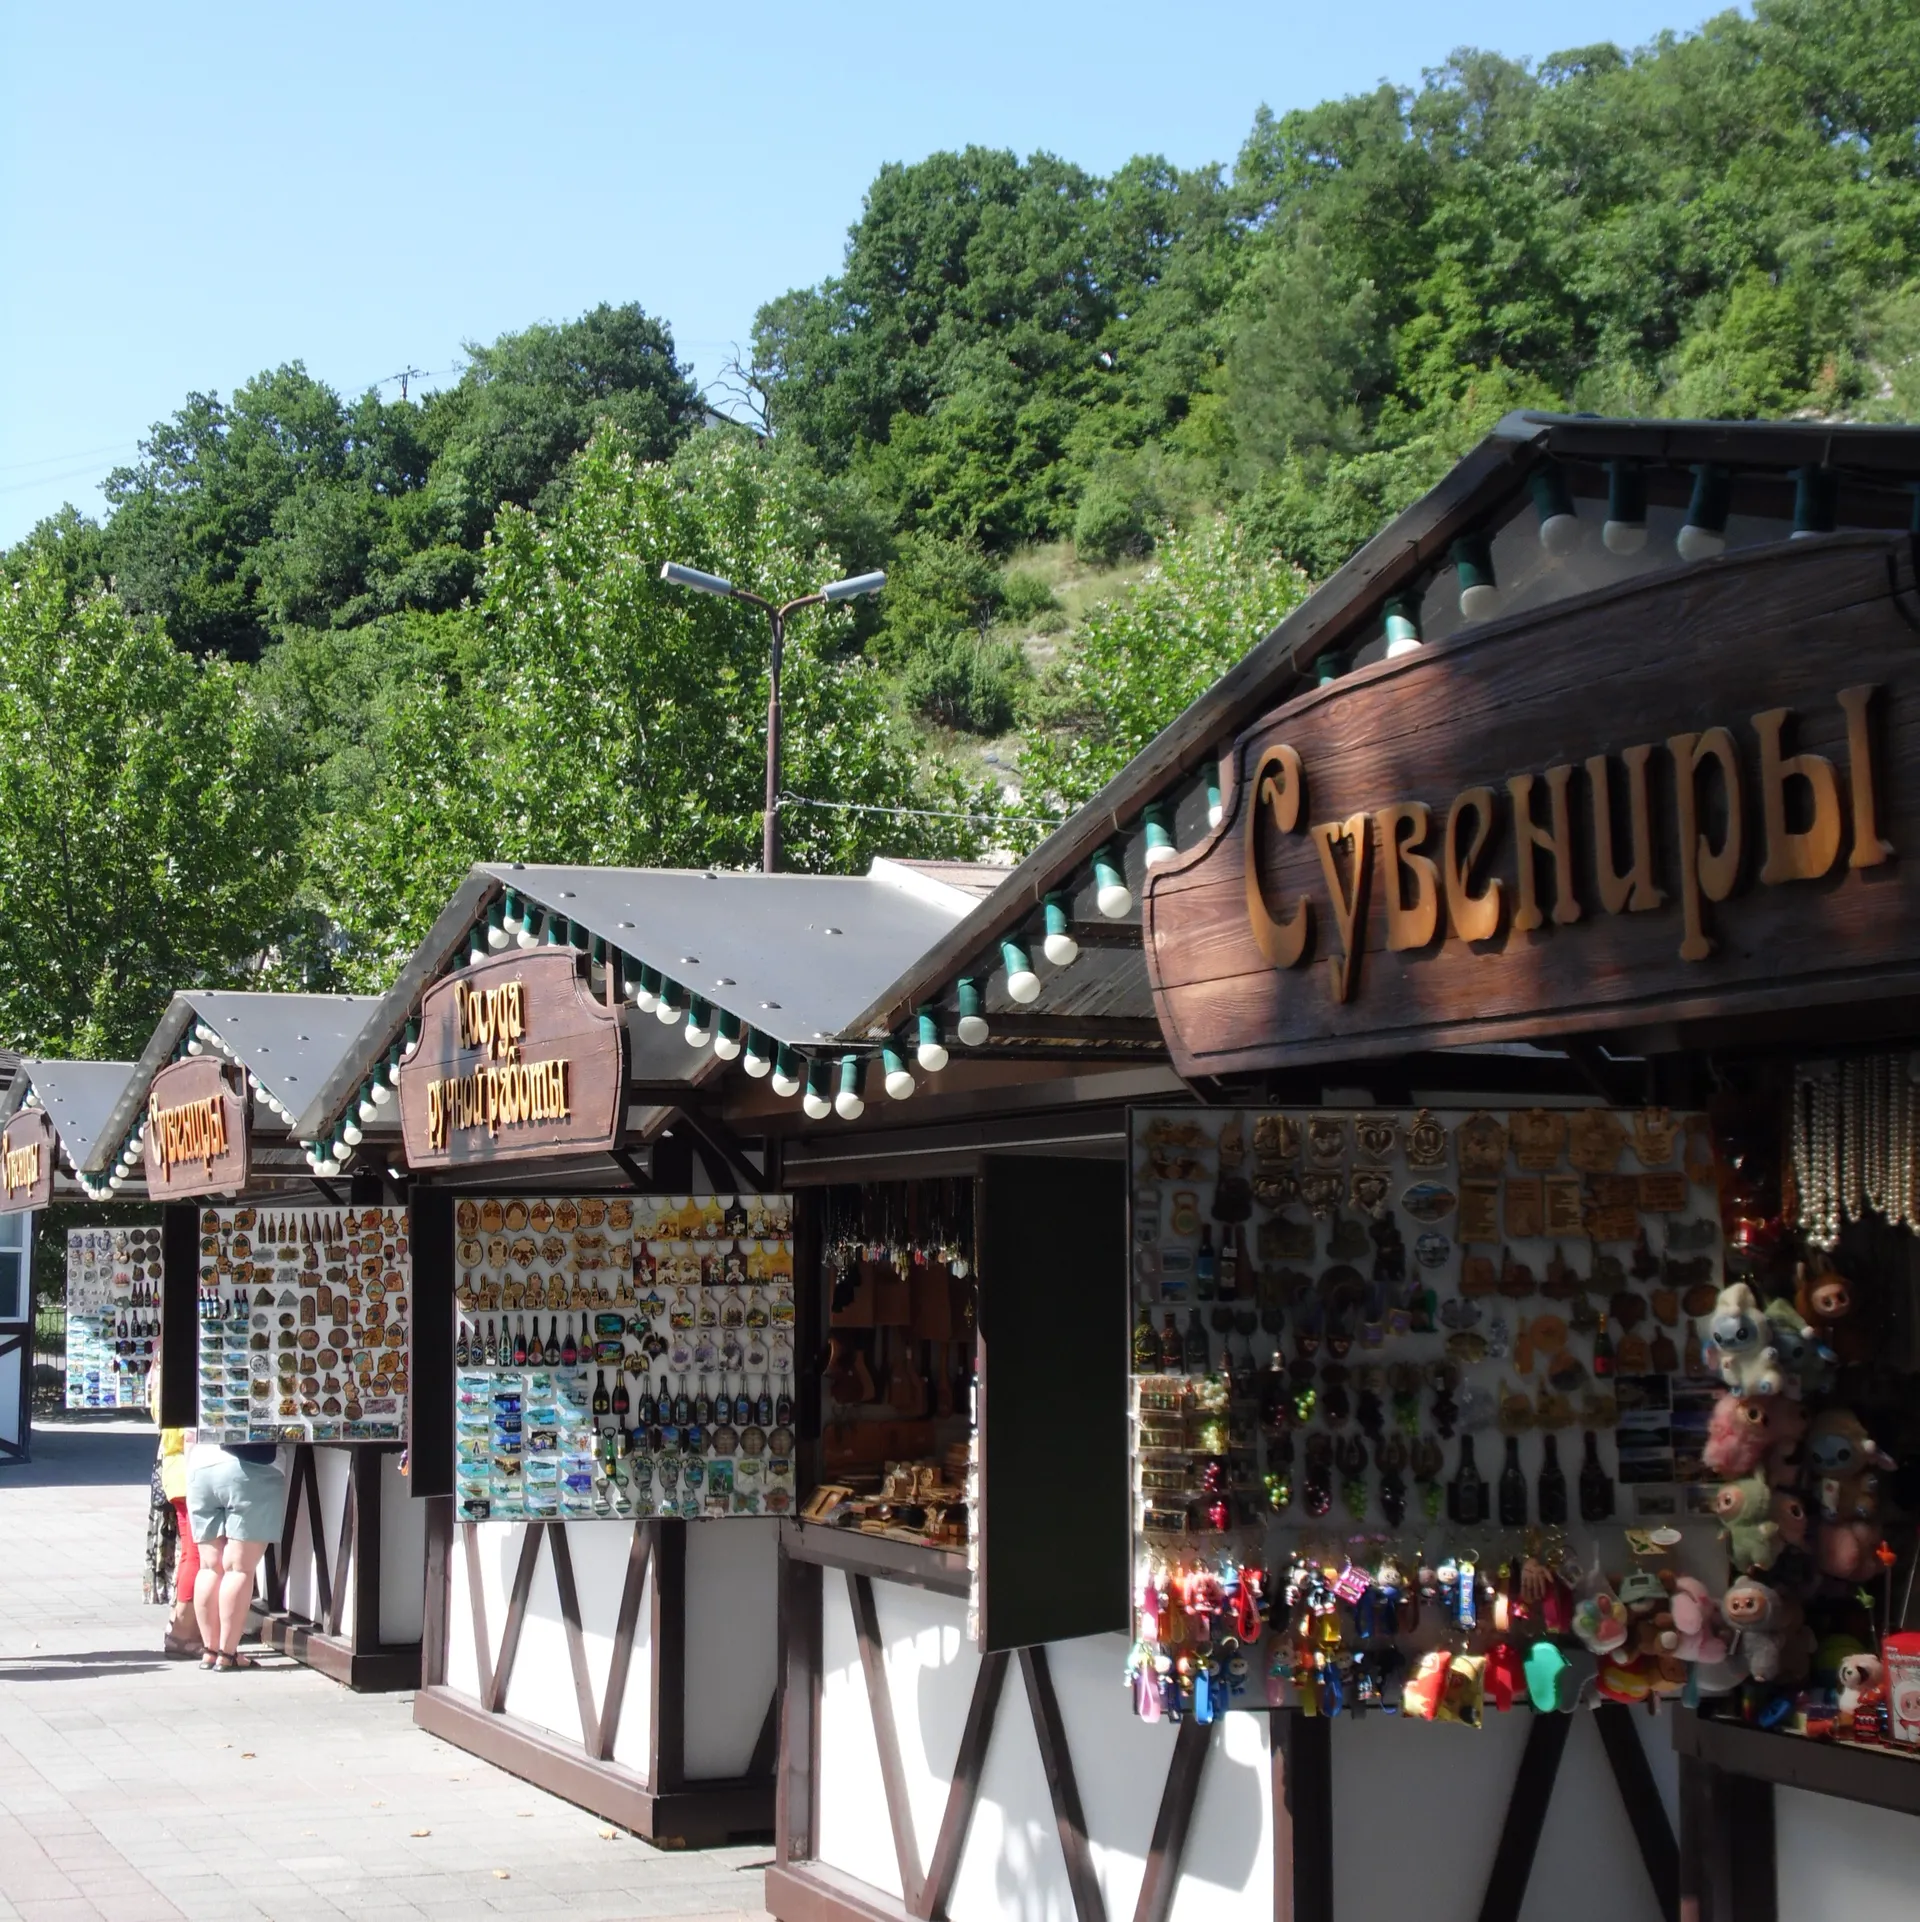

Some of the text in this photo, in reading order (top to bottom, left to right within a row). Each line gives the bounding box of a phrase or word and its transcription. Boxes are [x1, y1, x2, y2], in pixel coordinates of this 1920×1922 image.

[1246, 686, 1892, 1001] Сувениры
[455, 979, 524, 1060] Посуда
[149, 1092, 228, 1181] Сувениры
[427, 1046, 570, 1148] ручной работы
